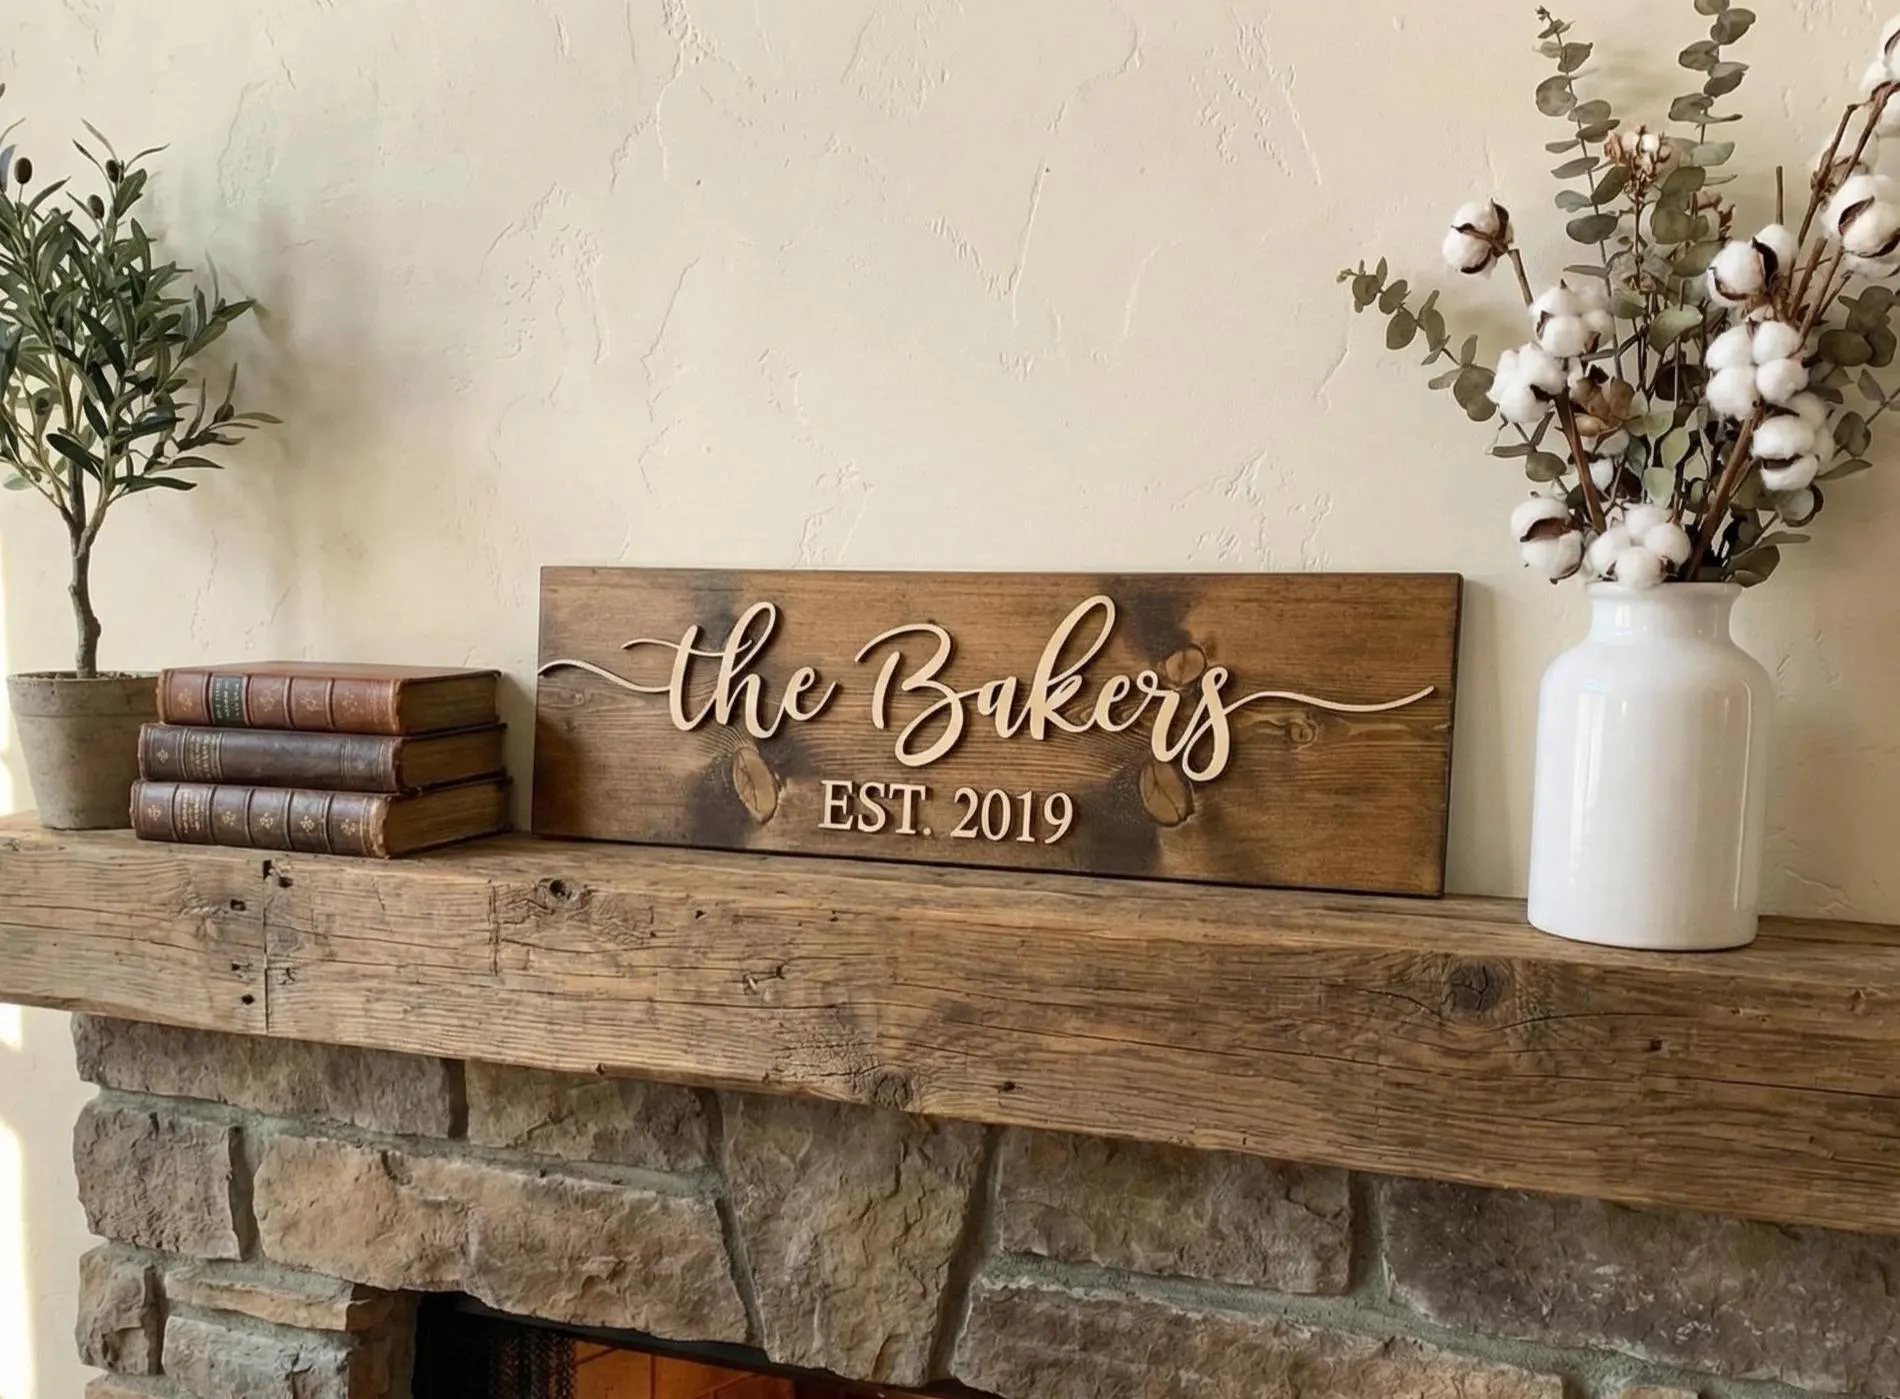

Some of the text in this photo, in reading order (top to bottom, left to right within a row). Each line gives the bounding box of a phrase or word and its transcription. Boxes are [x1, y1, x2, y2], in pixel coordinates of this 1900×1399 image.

[622, 594, 1231, 782] the Bakers
[819, 779, 1074, 845] EST. 2019
